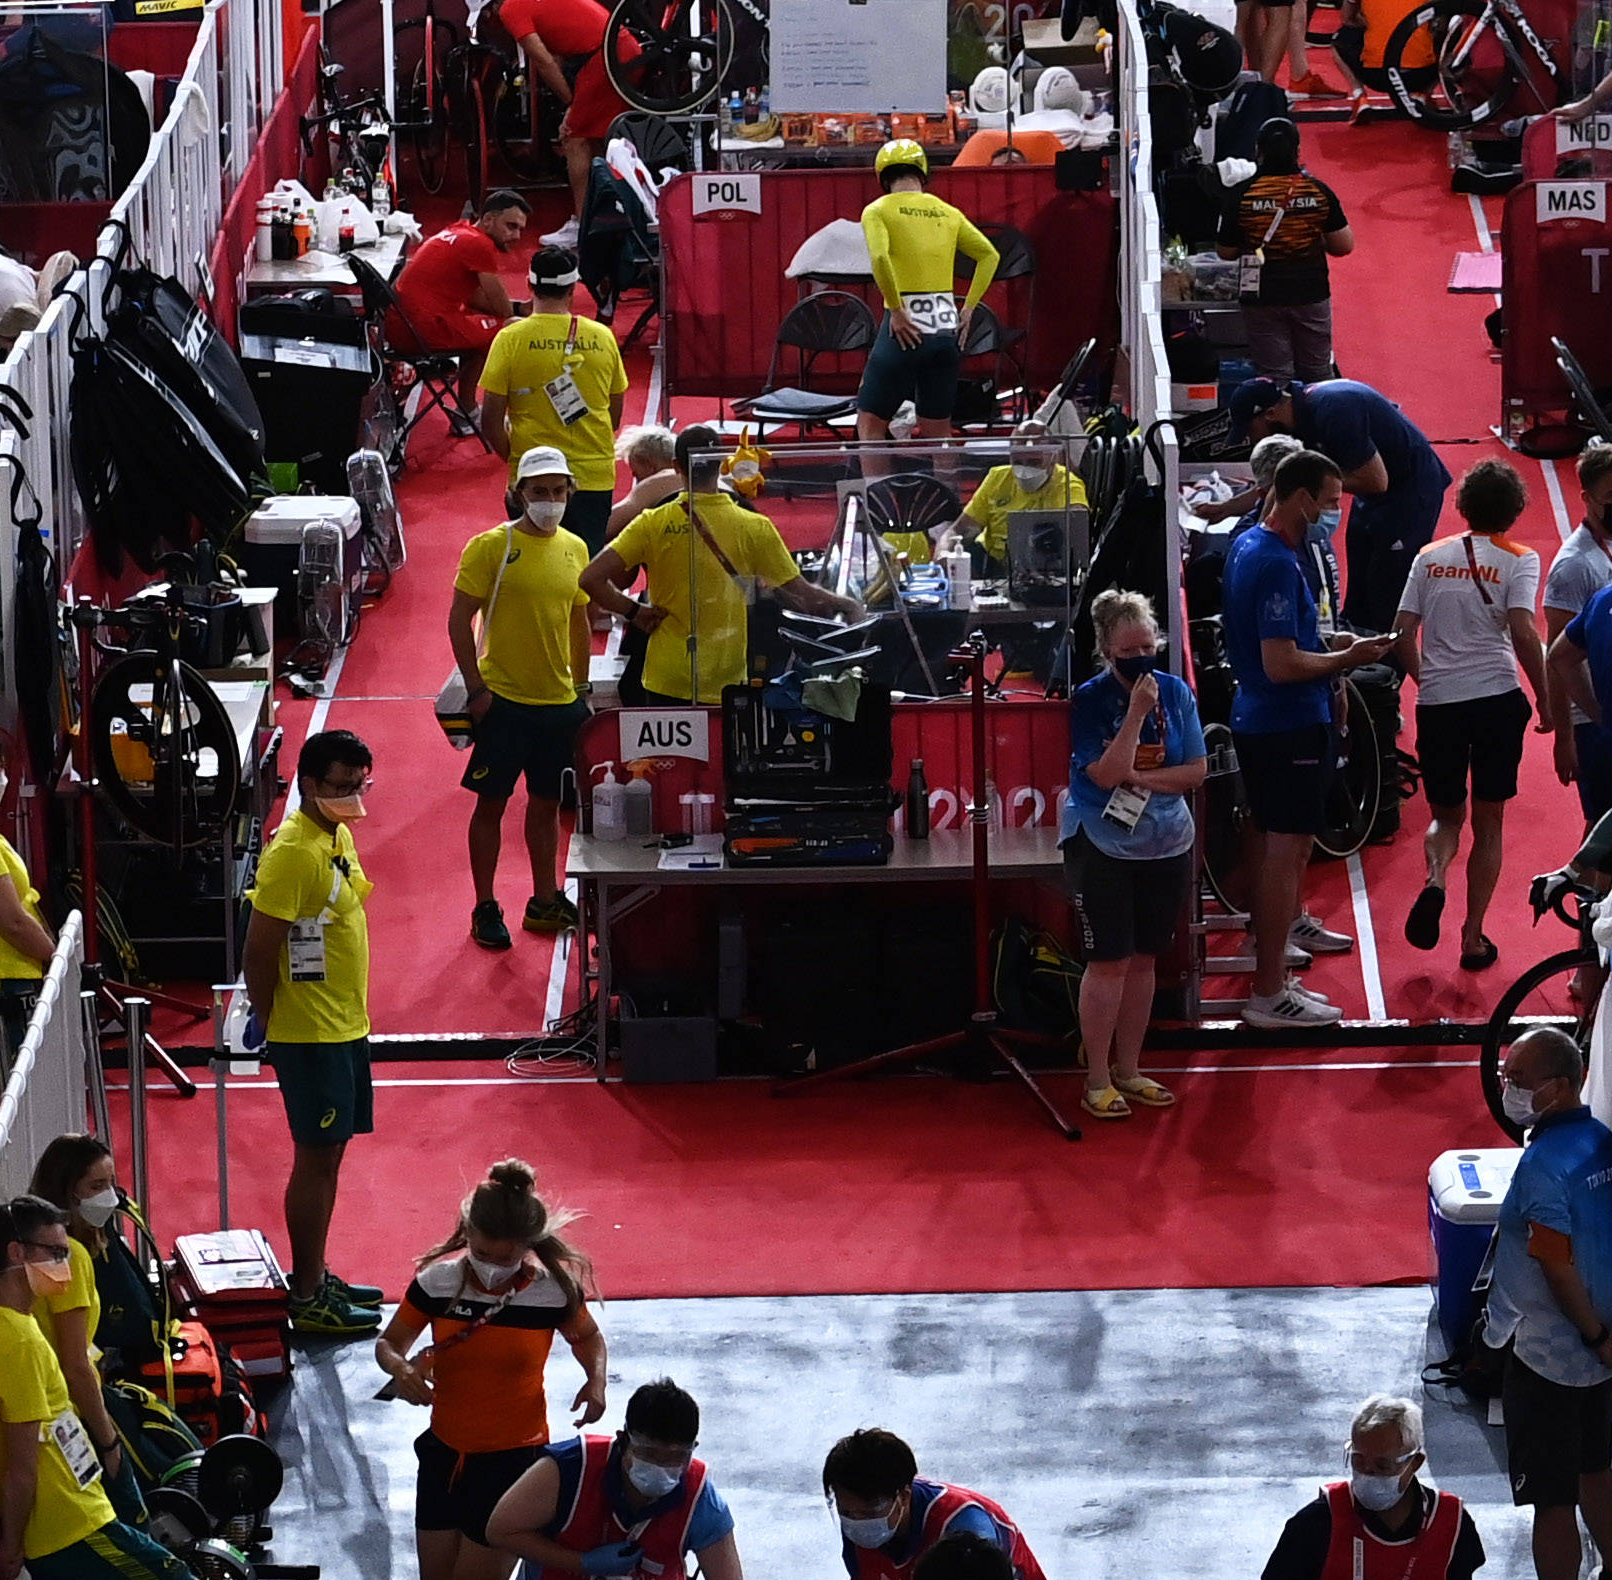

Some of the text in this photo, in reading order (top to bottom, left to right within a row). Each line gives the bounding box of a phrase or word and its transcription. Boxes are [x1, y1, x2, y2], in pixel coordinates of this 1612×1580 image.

[707, 182, 747, 202] POL
[1548, 190, 1596, 211] MAS
[1253, 198, 1318, 211] MALYSIA
[529, 340, 598, 353] AUSTALIA
[637, 720, 693, 748] AUS
